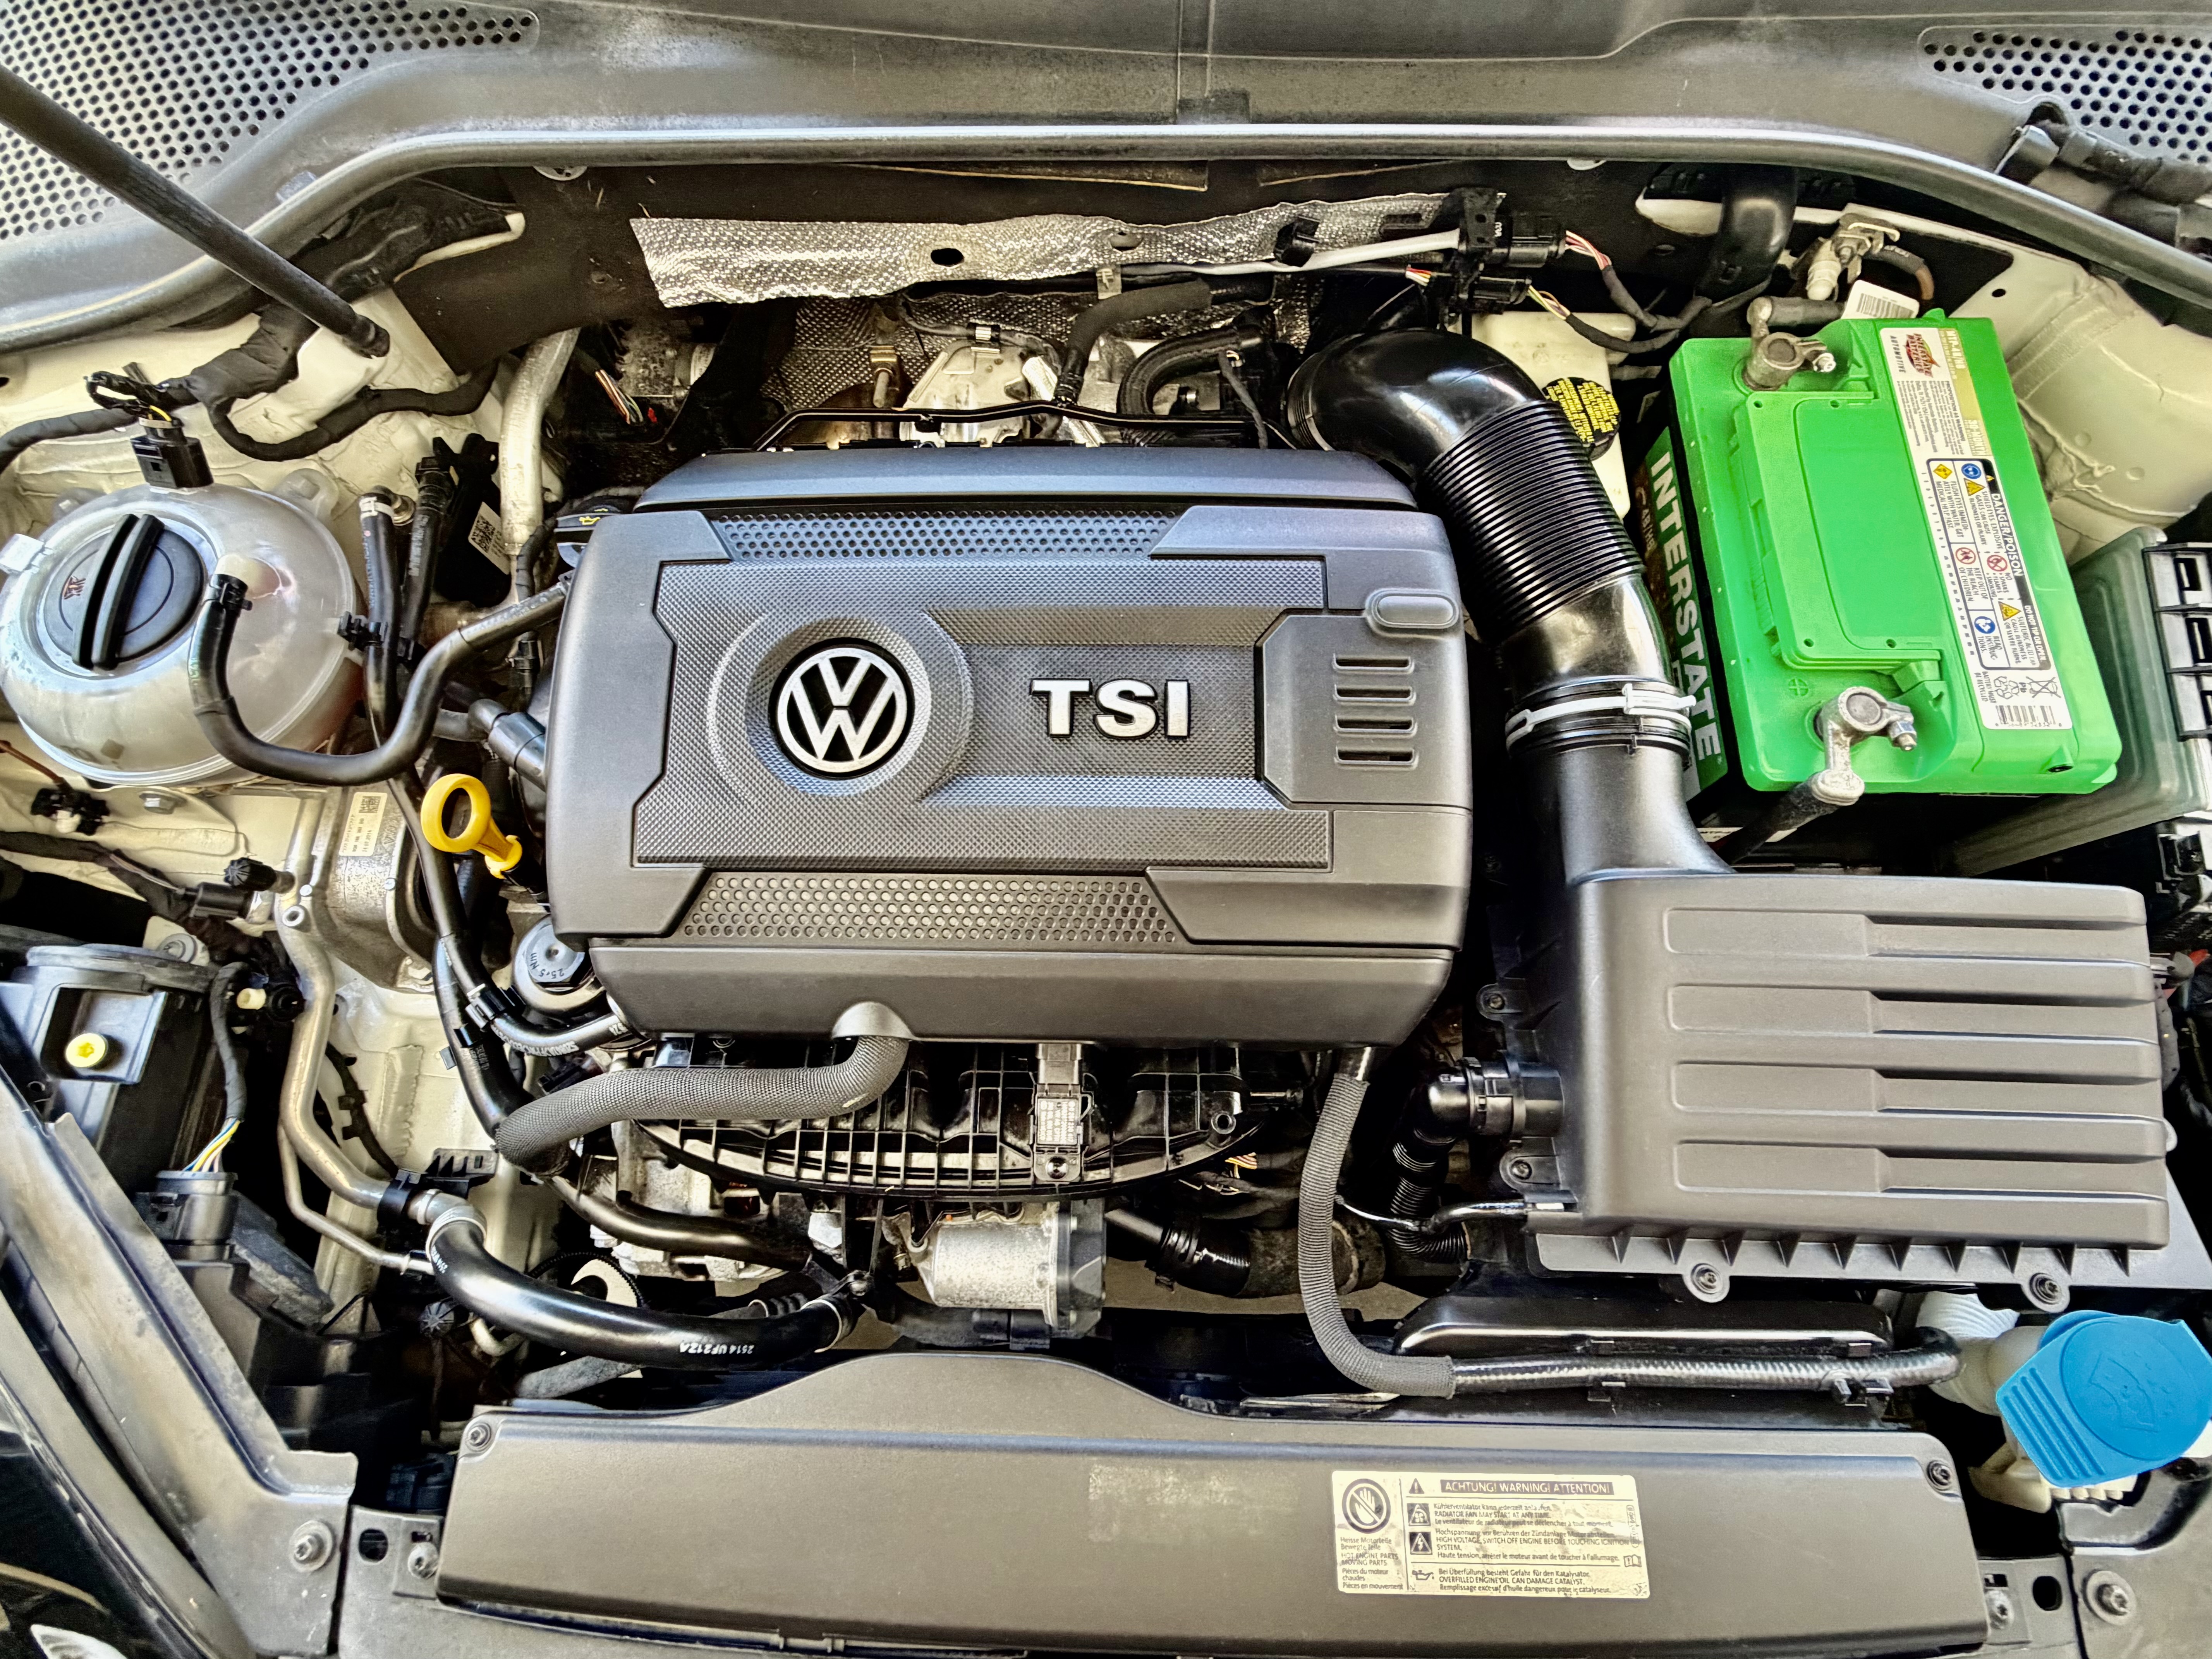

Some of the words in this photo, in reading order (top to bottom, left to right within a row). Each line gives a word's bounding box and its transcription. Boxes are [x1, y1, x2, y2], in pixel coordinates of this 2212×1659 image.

[1890, 336, 1906, 373] AUTOMOTIVE
[1942, 481, 1952, 495] ATELY
[1949, 481, 1960, 496] FLUSH
[1935, 481, 1947, 502] MEDICAL
[1941, 504, 1950, 515] HELP
[1946, 496, 1956, 508] WITH
[1954, 498, 1963, 508] EYES
[1975, 495, 1985, 510] GASES
[1982, 521, 1991, 534] CAUSE
[1982, 491, 1992, 508] SHIELD
[1990, 523, 2003, 549] EXPLOSIVE
[1955, 528, 1964, 537] GET
[1990, 493, 2023, 576] DANGER/POISON
[1966, 568, 1975, 577] THE
[1973, 568, 1983, 580] KEEP
[1960, 575, 1974, 601] CHILDREN
[1968, 578, 1980, 595] REACH
[1977, 581, 1986, 591] OUT
[1651, 452, 1722, 761] INTERSTATE
[2024, 605, 2033, 613] DO
[2027, 615, 2036, 625] NOT
[2017, 617, 2030, 641] SULFURIC
[2024, 642, 2034, 655] ACID
[2030, 626, 2039, 635] TIP
[2018, 682, 2028, 692] Pb
[779, 647, 908, 773] VW
[1030, 679, 1190, 738] TSI
[1444, 1481, 1497, 1492] ACHTUNG!
[1499, 1482, 1551, 1493] WARNING!
[1553, 1482, 1610, 1494] ATTENTION!
[1440, 1584, 1477, 1592] Remplissage
